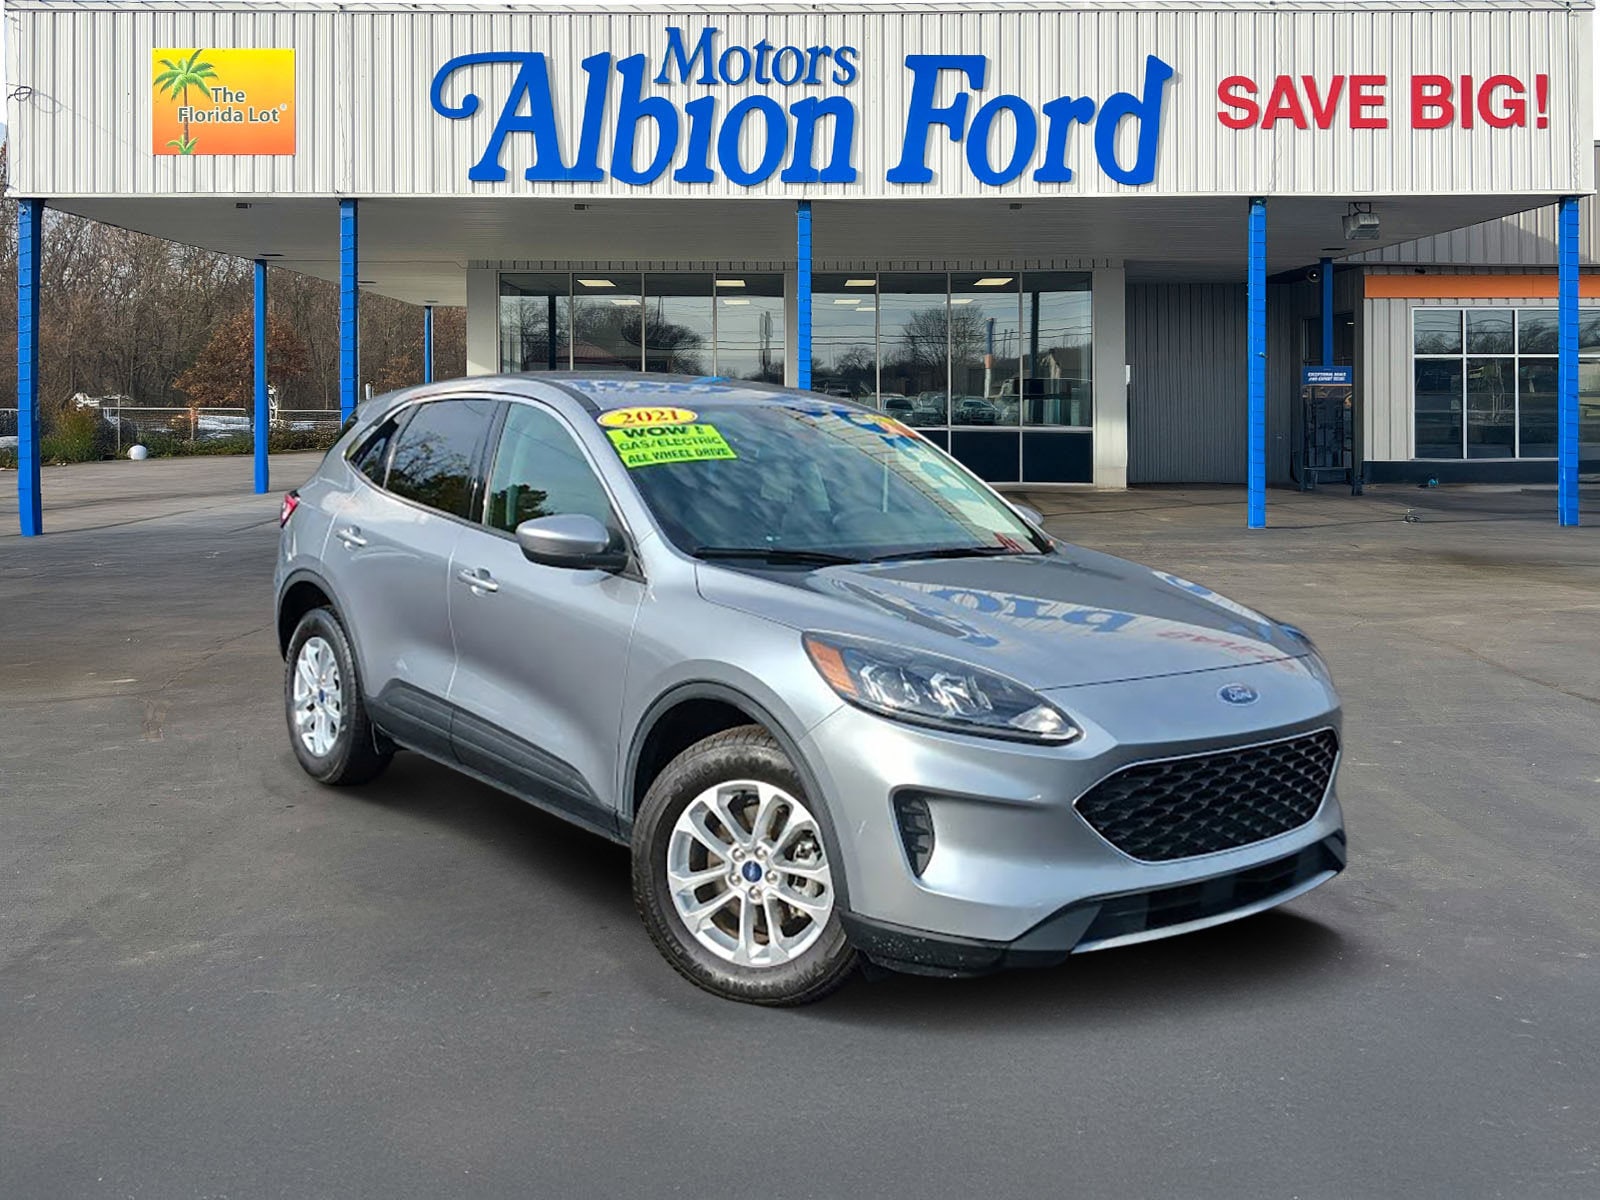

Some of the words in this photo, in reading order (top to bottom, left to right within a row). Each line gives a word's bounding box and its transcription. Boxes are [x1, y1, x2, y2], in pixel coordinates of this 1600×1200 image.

[654, 27, 858, 85] Motors
[211, 87, 246, 103] The
[1217, 74, 1388, 129] SAVE
[1411, 74, 1549, 129] BIG!
[178, 107, 243, 122] Florida
[248, 107, 279, 122] Lot
[430, 52, 857, 186] Albion
[887, 55, 1176, 186] Ford
[617, 409, 679, 424] 2021
[623, 426, 687, 438] WOW
[620, 436, 723, 451] GAS/ELECTRIC
[627, 454, 651, 464] ALL
[652, 449, 694, 460] WHEEL
[694, 447, 729, 457] DRIVE
